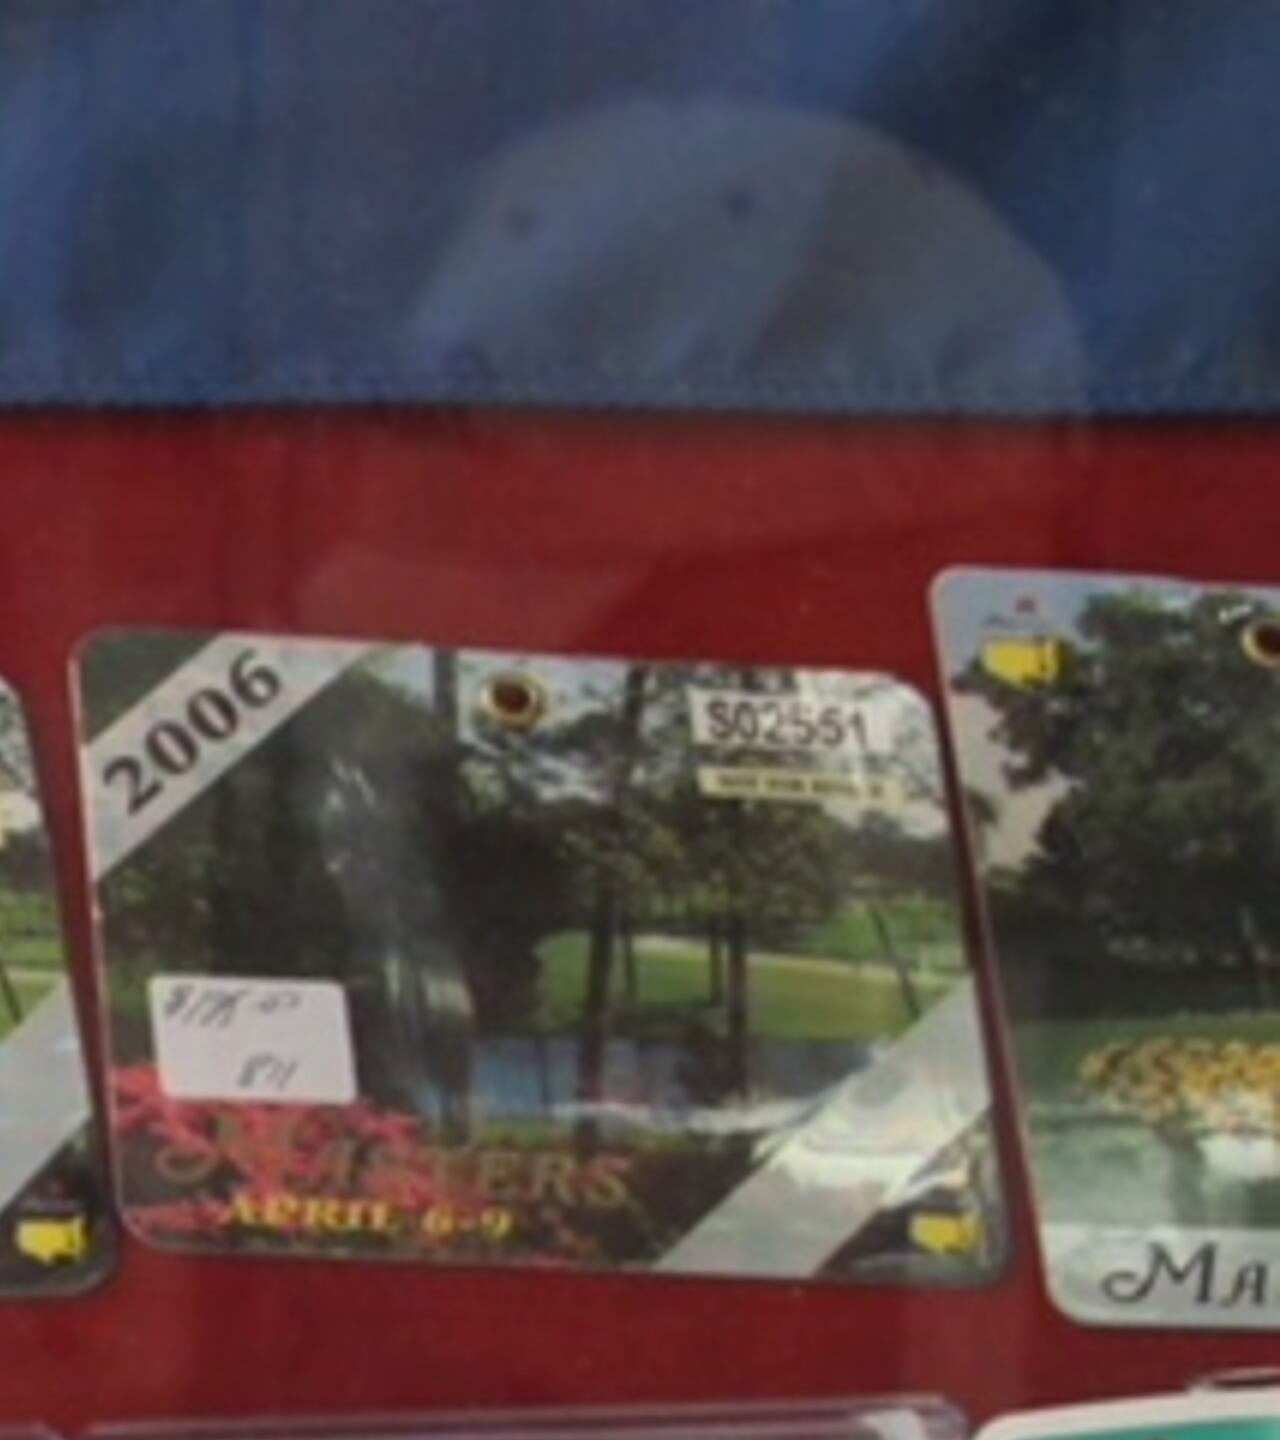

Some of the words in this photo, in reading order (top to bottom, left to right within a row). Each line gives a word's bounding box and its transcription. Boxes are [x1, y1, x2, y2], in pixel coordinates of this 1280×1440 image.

[100, 648, 285, 815] 2006
[707, 698, 867, 747] S02551
[218, 1193, 400, 1231] APRIL
[422, 1204, 516, 1239] 6-9
